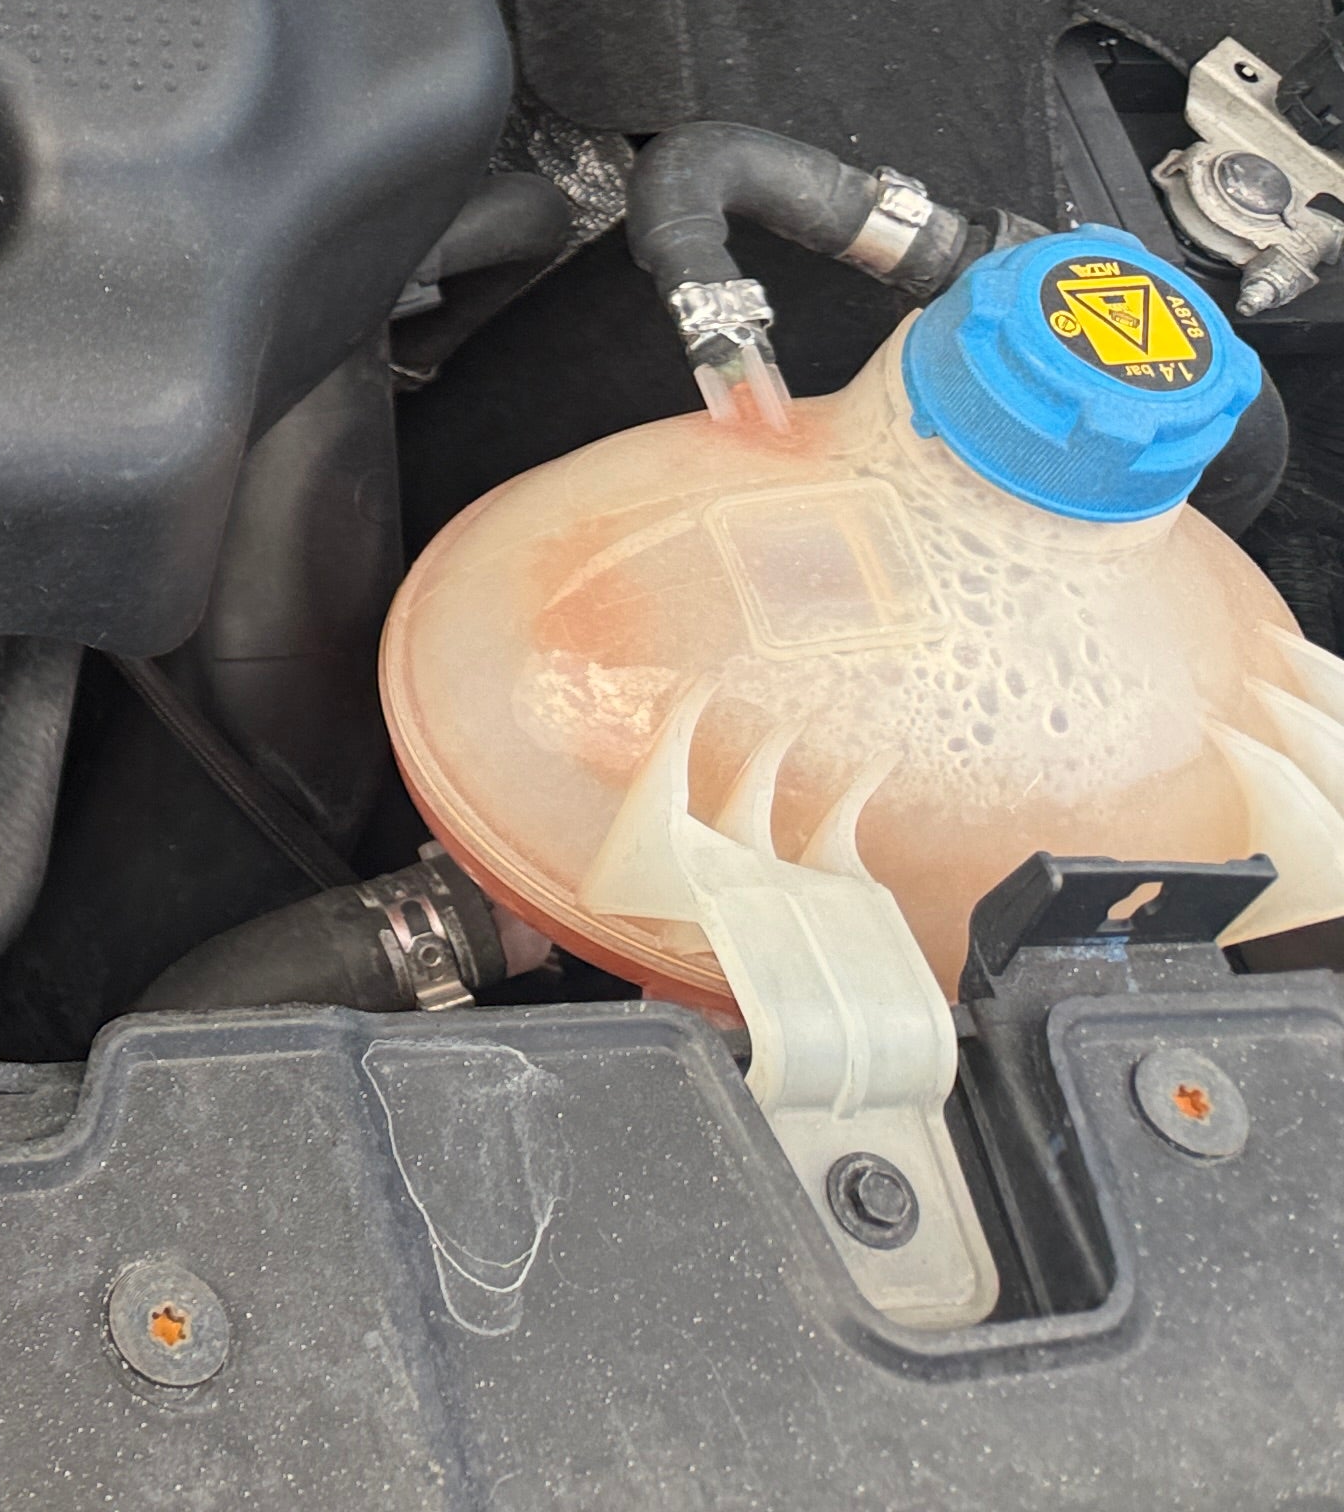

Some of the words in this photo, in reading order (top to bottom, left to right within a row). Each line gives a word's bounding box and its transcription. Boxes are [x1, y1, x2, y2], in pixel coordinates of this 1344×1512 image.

[1166, 295, 1205, 340] A878
[1125, 364, 1155, 378] bar
[1159, 361, 1194, 383] 1.4
